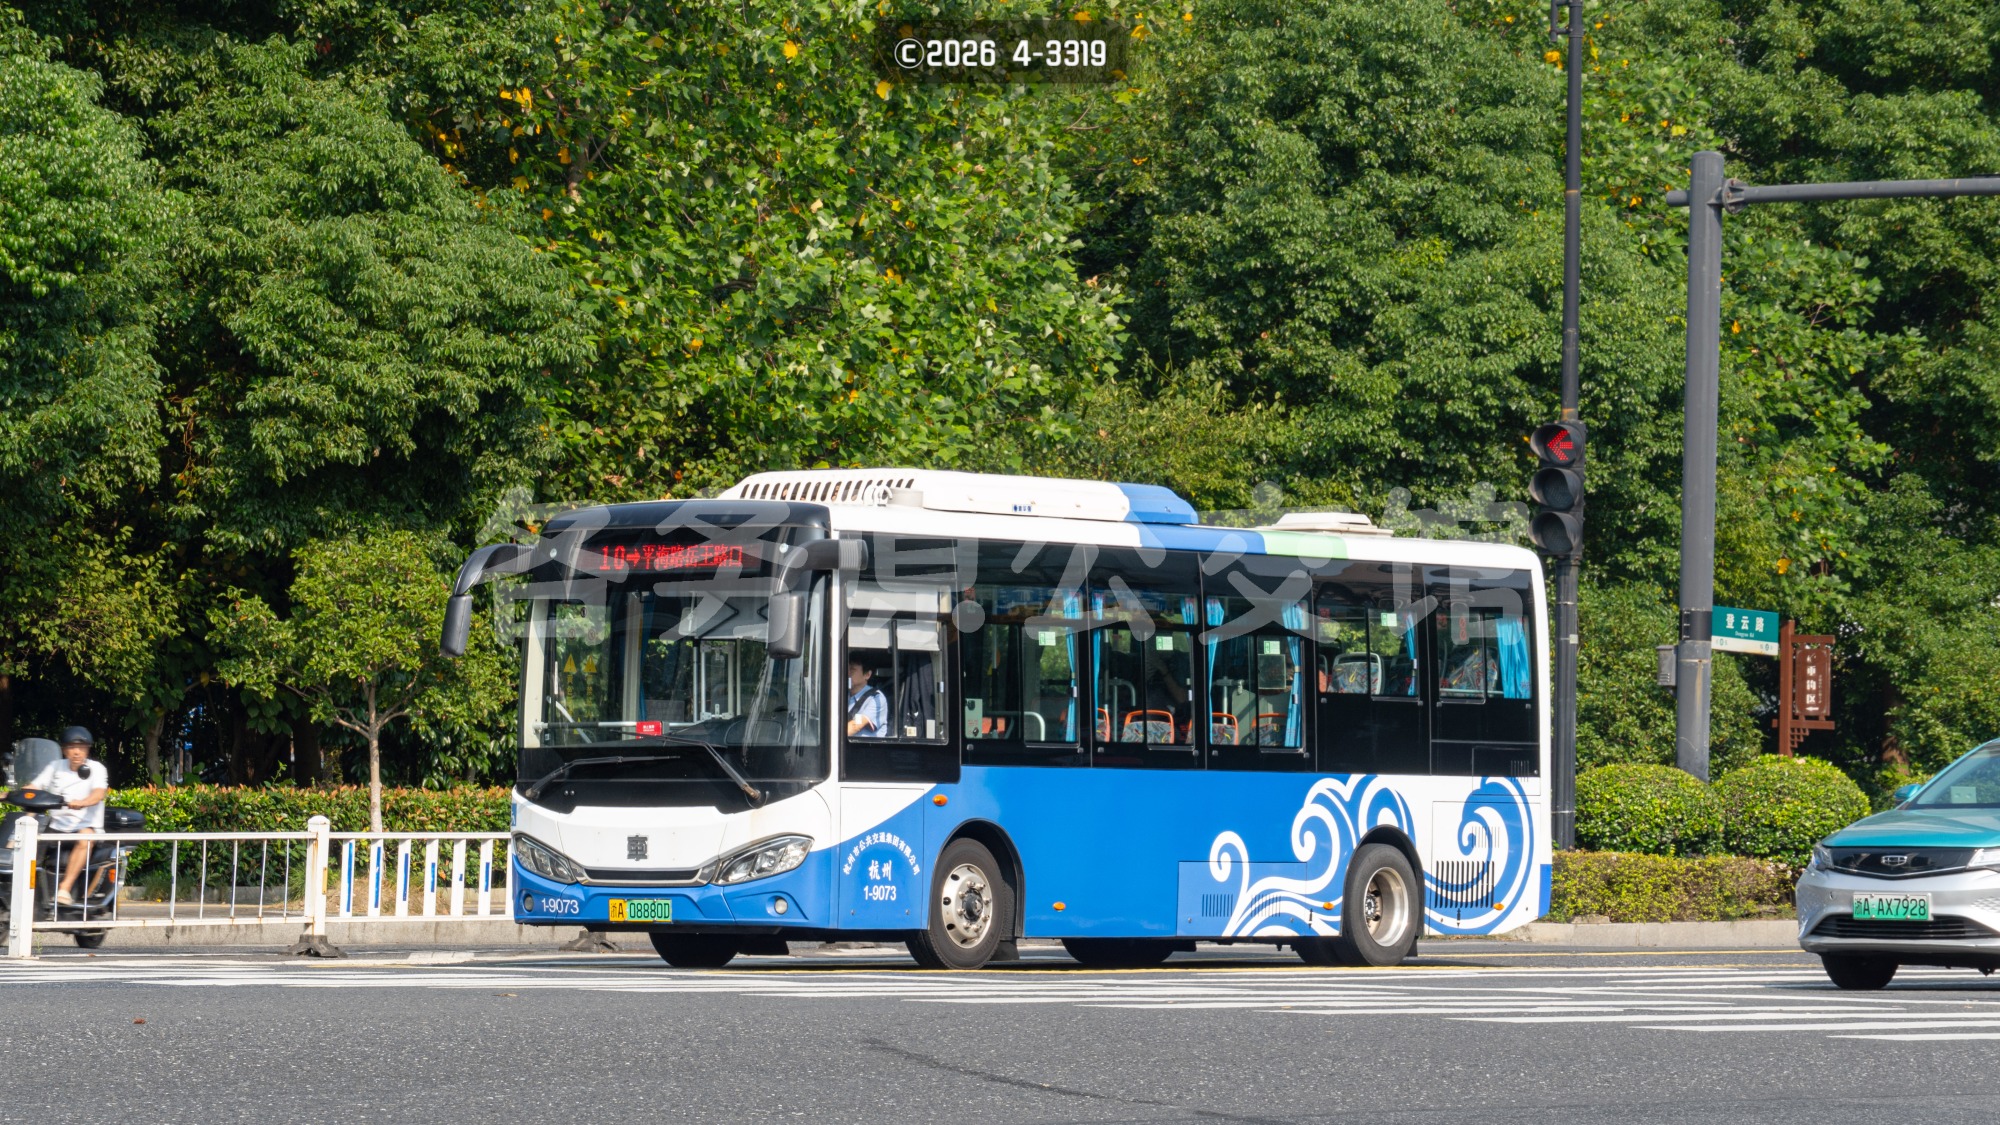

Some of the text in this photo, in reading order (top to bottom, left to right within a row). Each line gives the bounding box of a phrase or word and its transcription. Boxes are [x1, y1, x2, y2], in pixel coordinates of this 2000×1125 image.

[599, 545, 625, 570] 10
[1725, 613, 1764, 632] 登云路
[868, 859, 892, 881] 杭州
[863, 884, 897, 901] 1-9073
[541, 897, 579, 914] 1-9073
